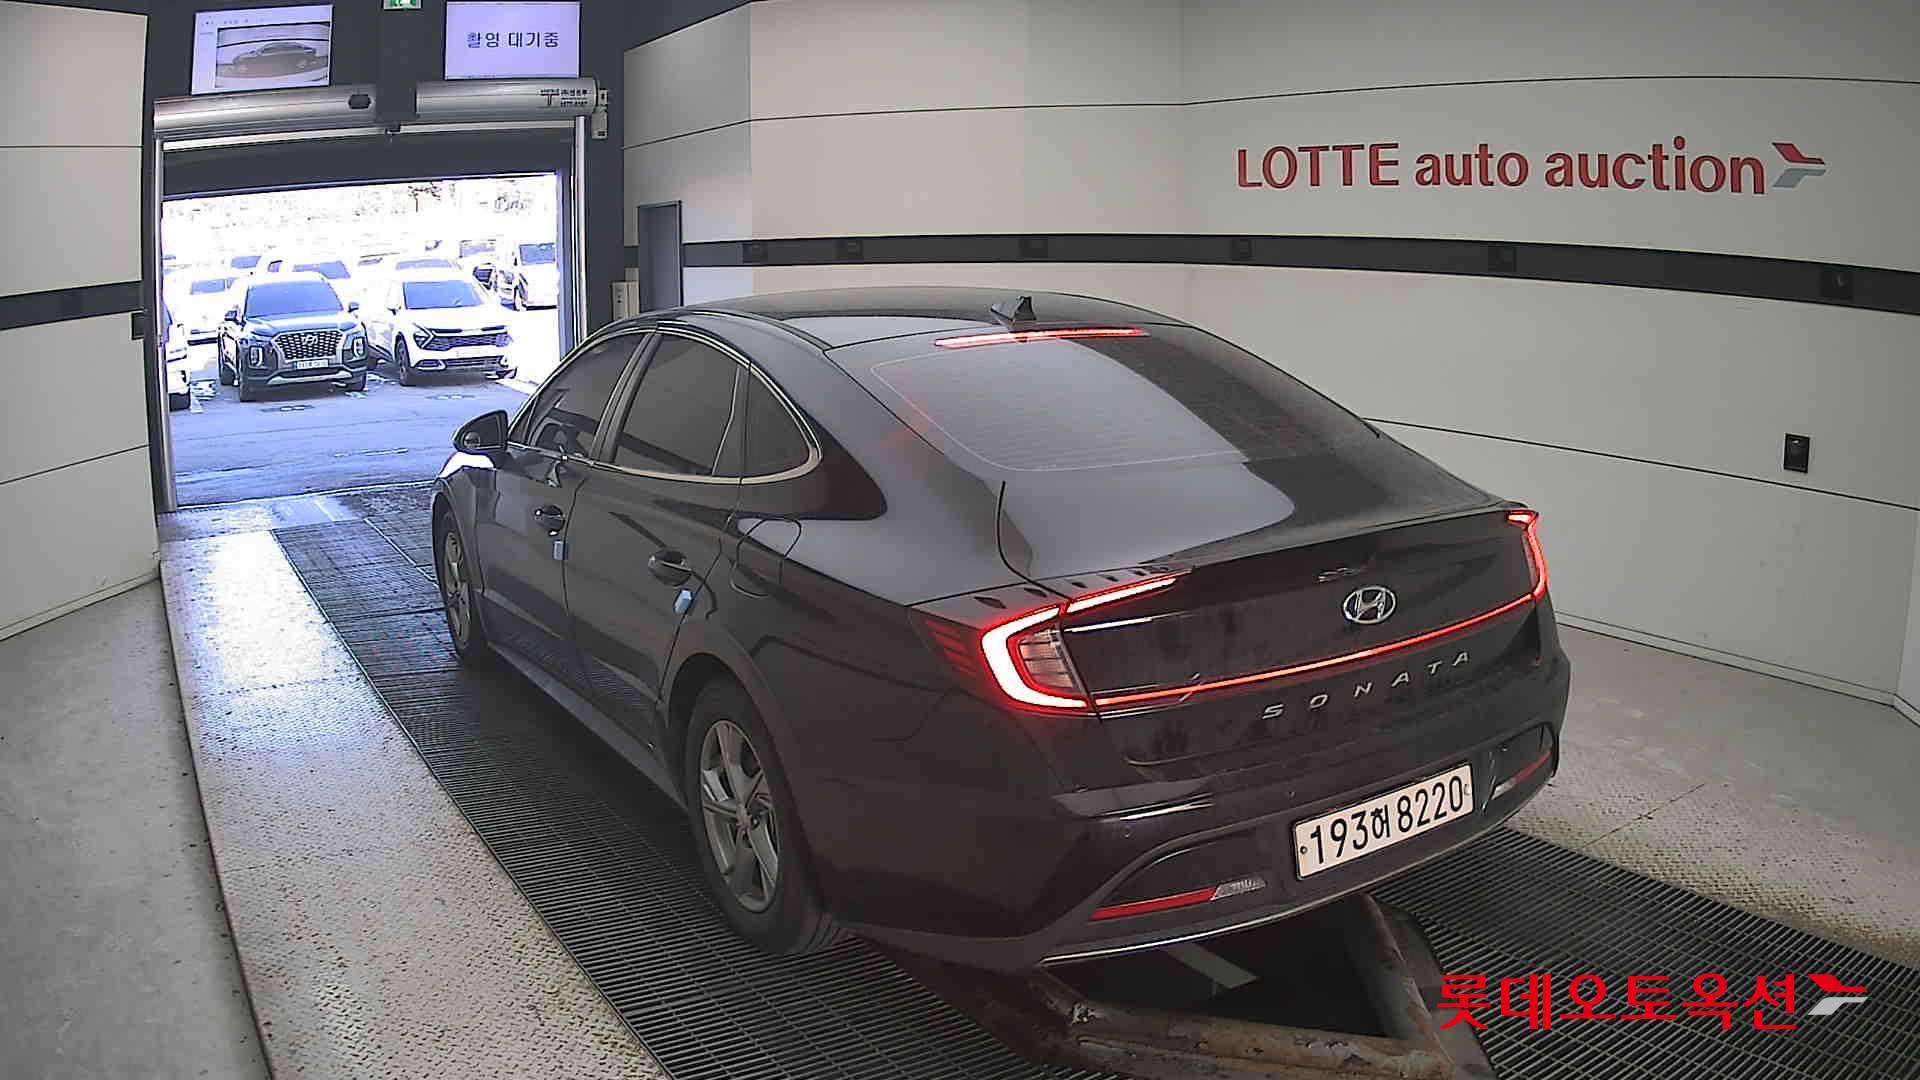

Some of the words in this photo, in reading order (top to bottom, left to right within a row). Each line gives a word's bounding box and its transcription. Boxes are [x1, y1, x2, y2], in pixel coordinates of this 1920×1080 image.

[508, 31, 560, 49] 대기중
[1237, 143, 1399, 189] LOTTE
[1415, 145, 1529, 187] auto
[1545, 136, 1766, 195] auction
[1261, 651, 1470, 719] SONATA
[1310, 804, 1391, 865] 193허
[1397, 775, 1463, 834] 8220
